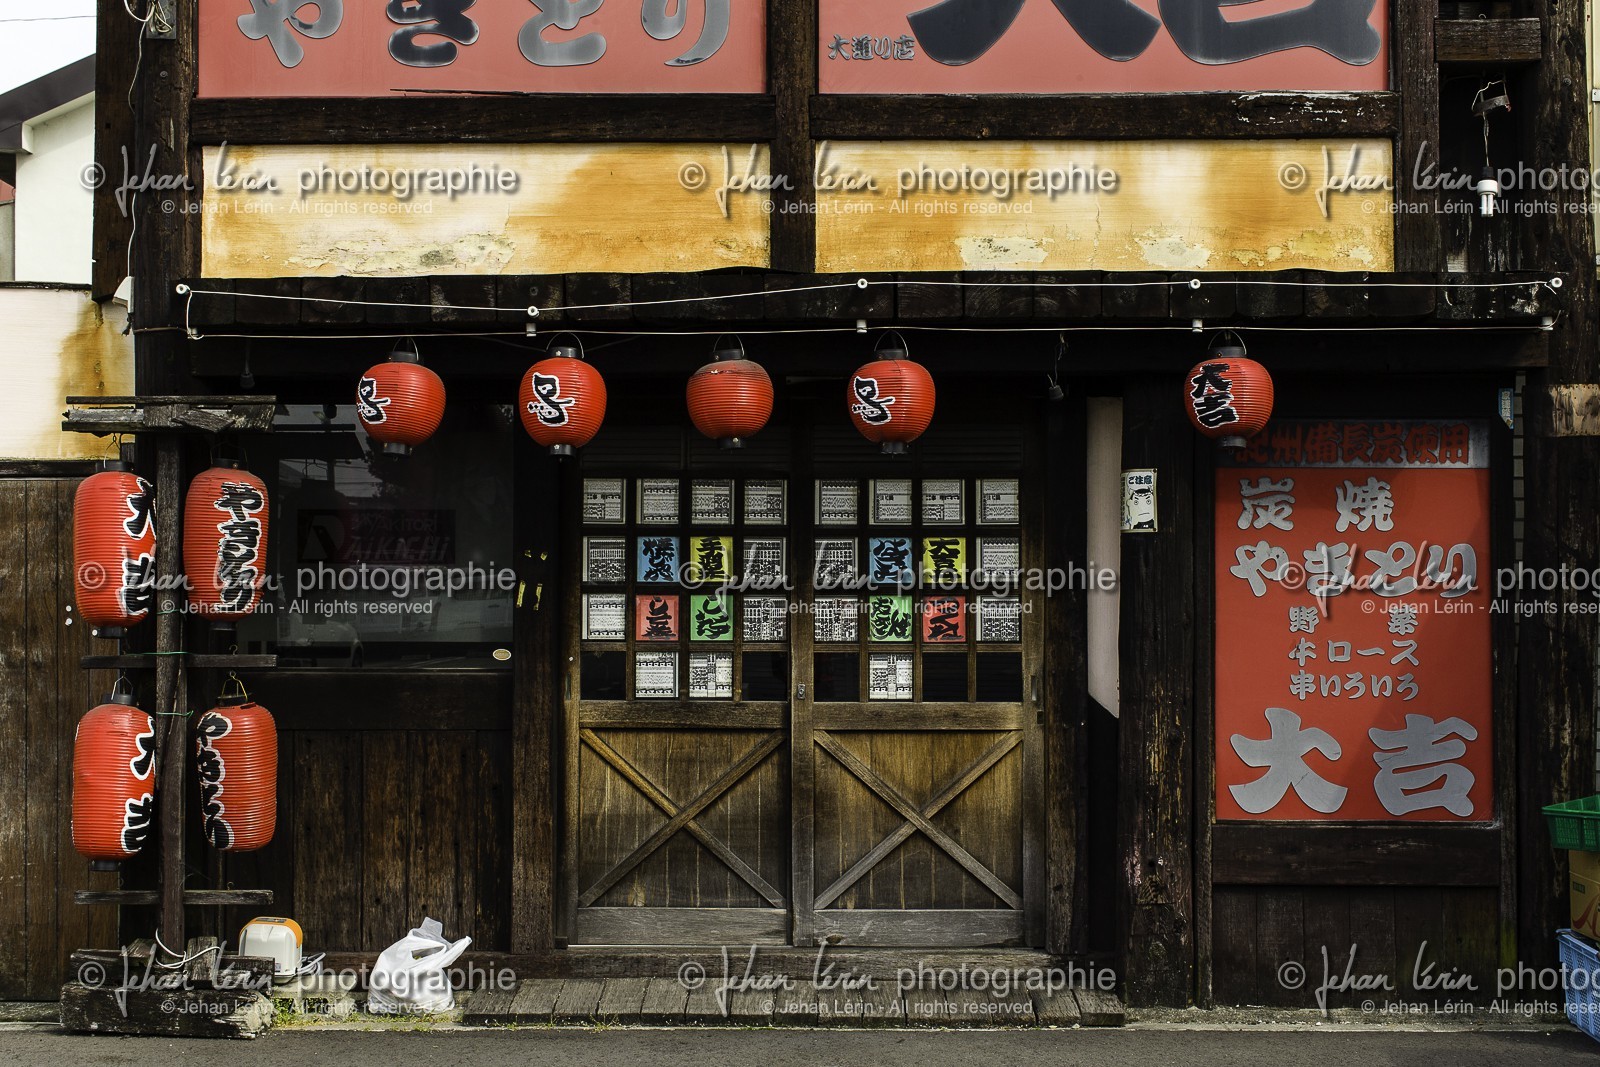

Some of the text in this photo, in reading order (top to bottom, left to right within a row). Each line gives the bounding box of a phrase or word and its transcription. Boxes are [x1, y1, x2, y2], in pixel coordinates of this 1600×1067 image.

[1289, 670, 1420, 701] 串いろいろ
[1228, 707, 1479, 816] 大吉
